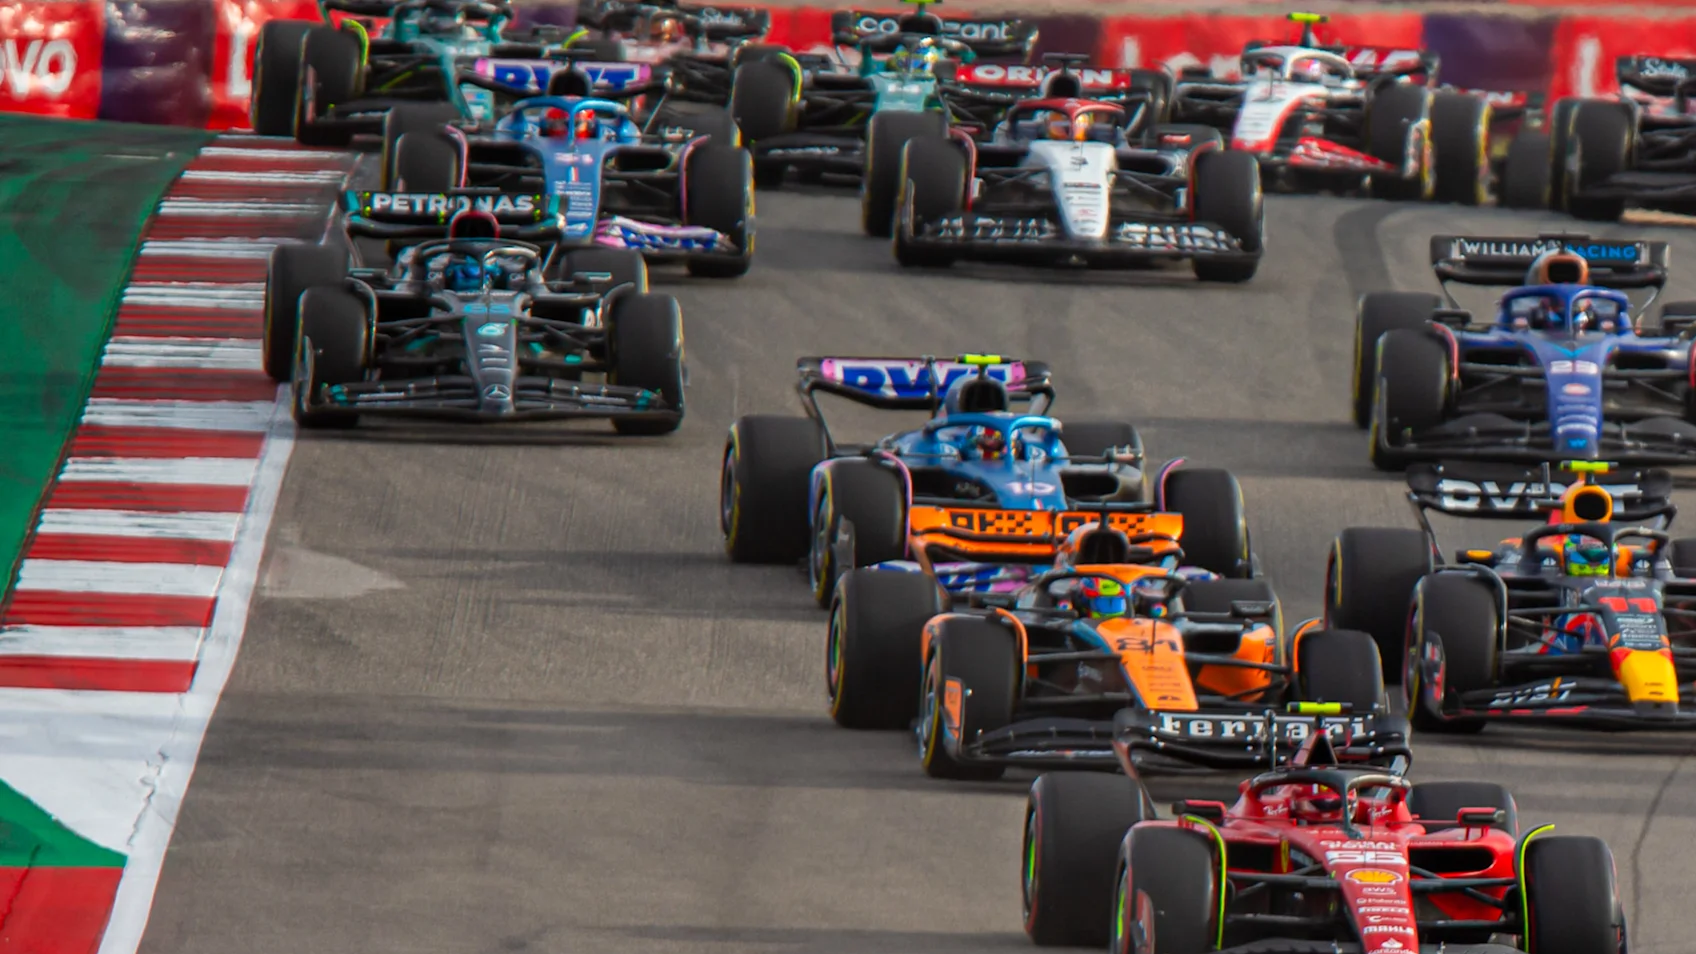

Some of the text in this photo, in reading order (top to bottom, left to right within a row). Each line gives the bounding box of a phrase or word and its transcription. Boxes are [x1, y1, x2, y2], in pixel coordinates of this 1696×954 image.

[1006, 482, 1055, 494] 10
[1598, 596, 1657, 613] 11
[1325, 851, 1407, 865] 55
